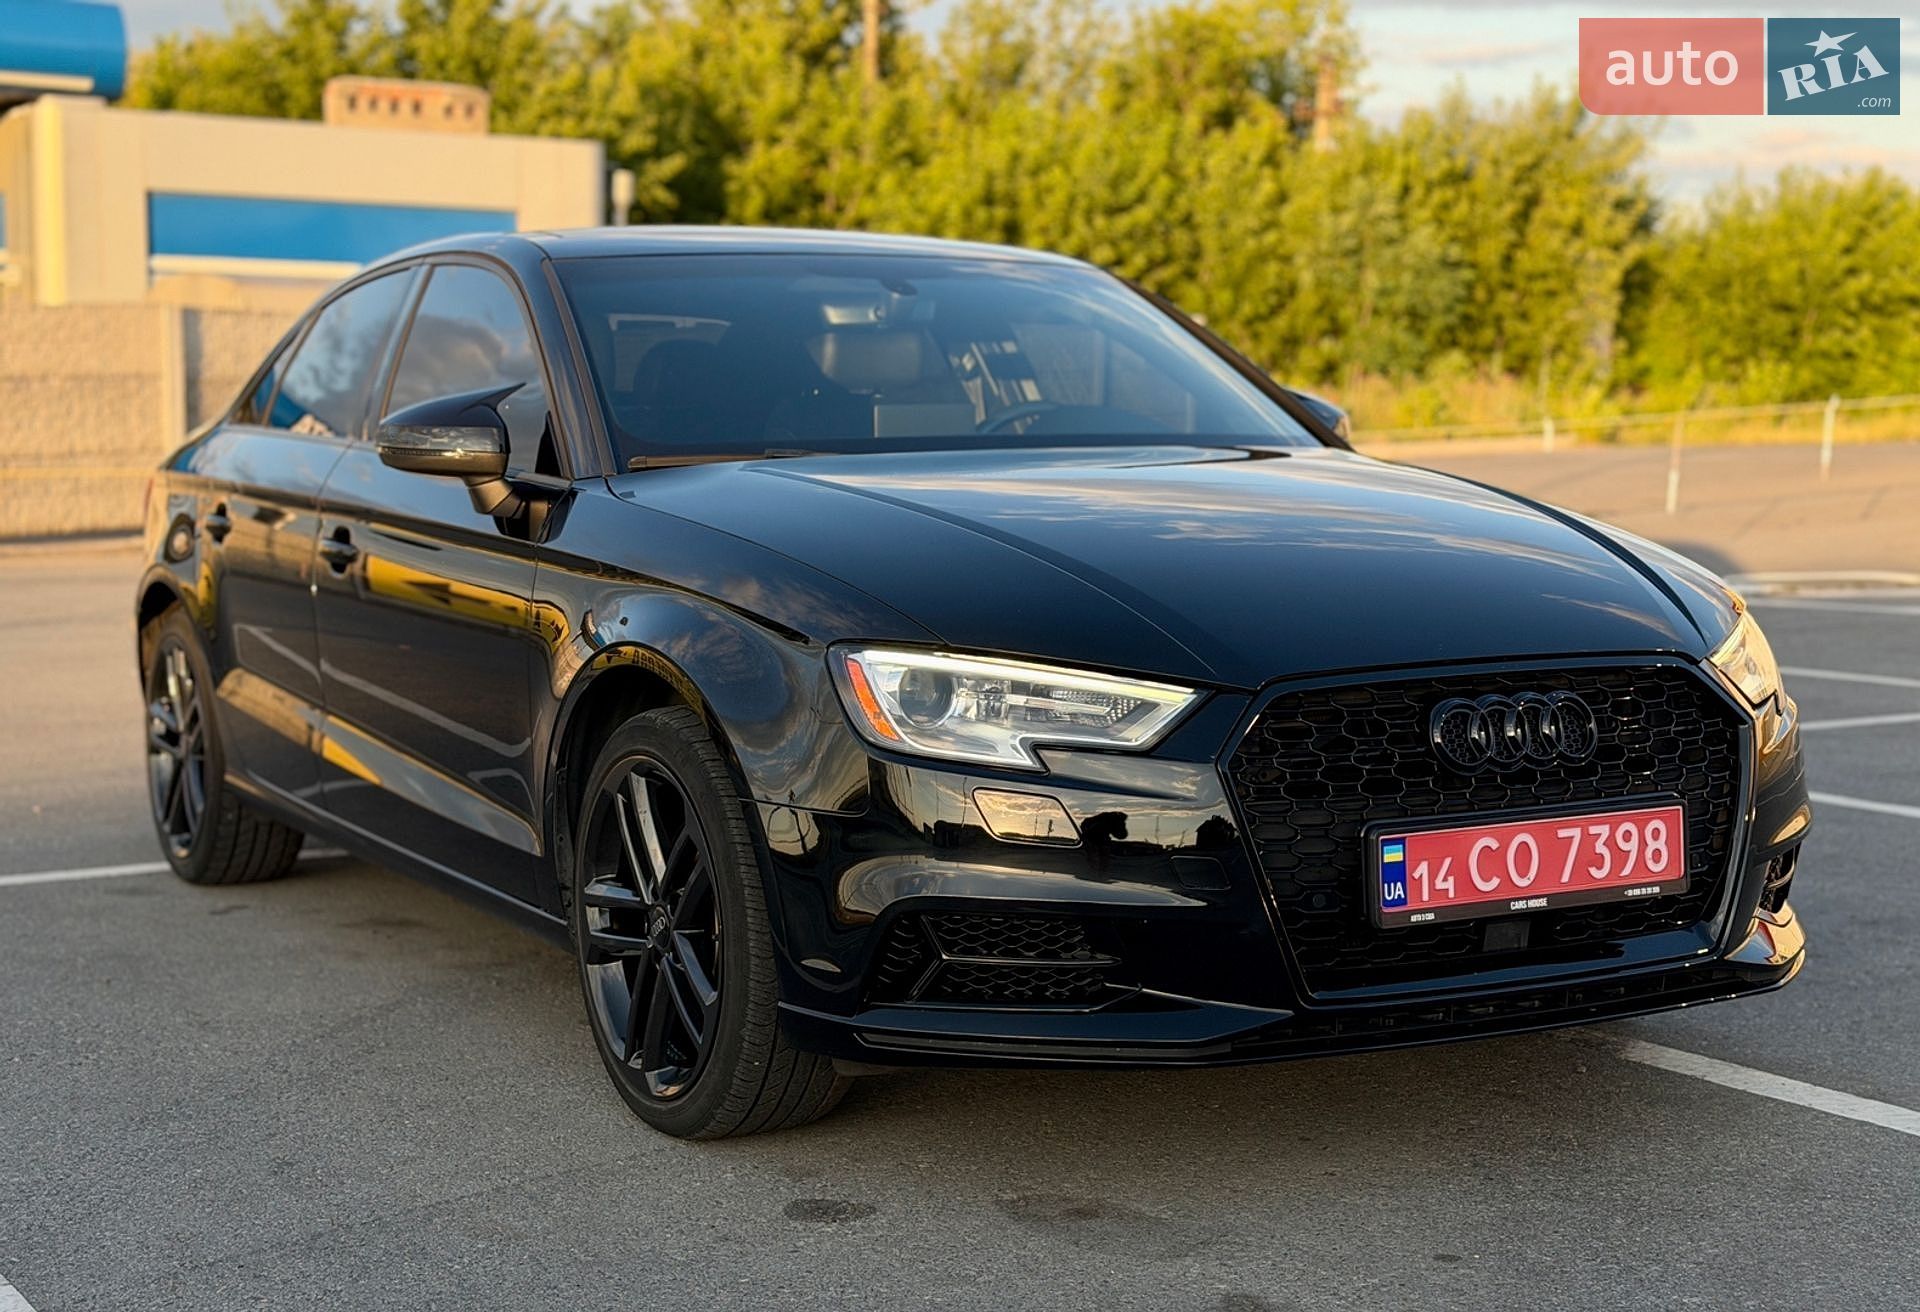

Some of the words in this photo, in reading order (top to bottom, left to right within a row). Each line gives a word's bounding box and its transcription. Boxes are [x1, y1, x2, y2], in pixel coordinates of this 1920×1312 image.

[1411, 857, 1456, 902] 14
[1468, 832, 1540, 893] CO
[1556, 819, 1670, 884] 7398
[1384, 882, 1405, 900] UA
